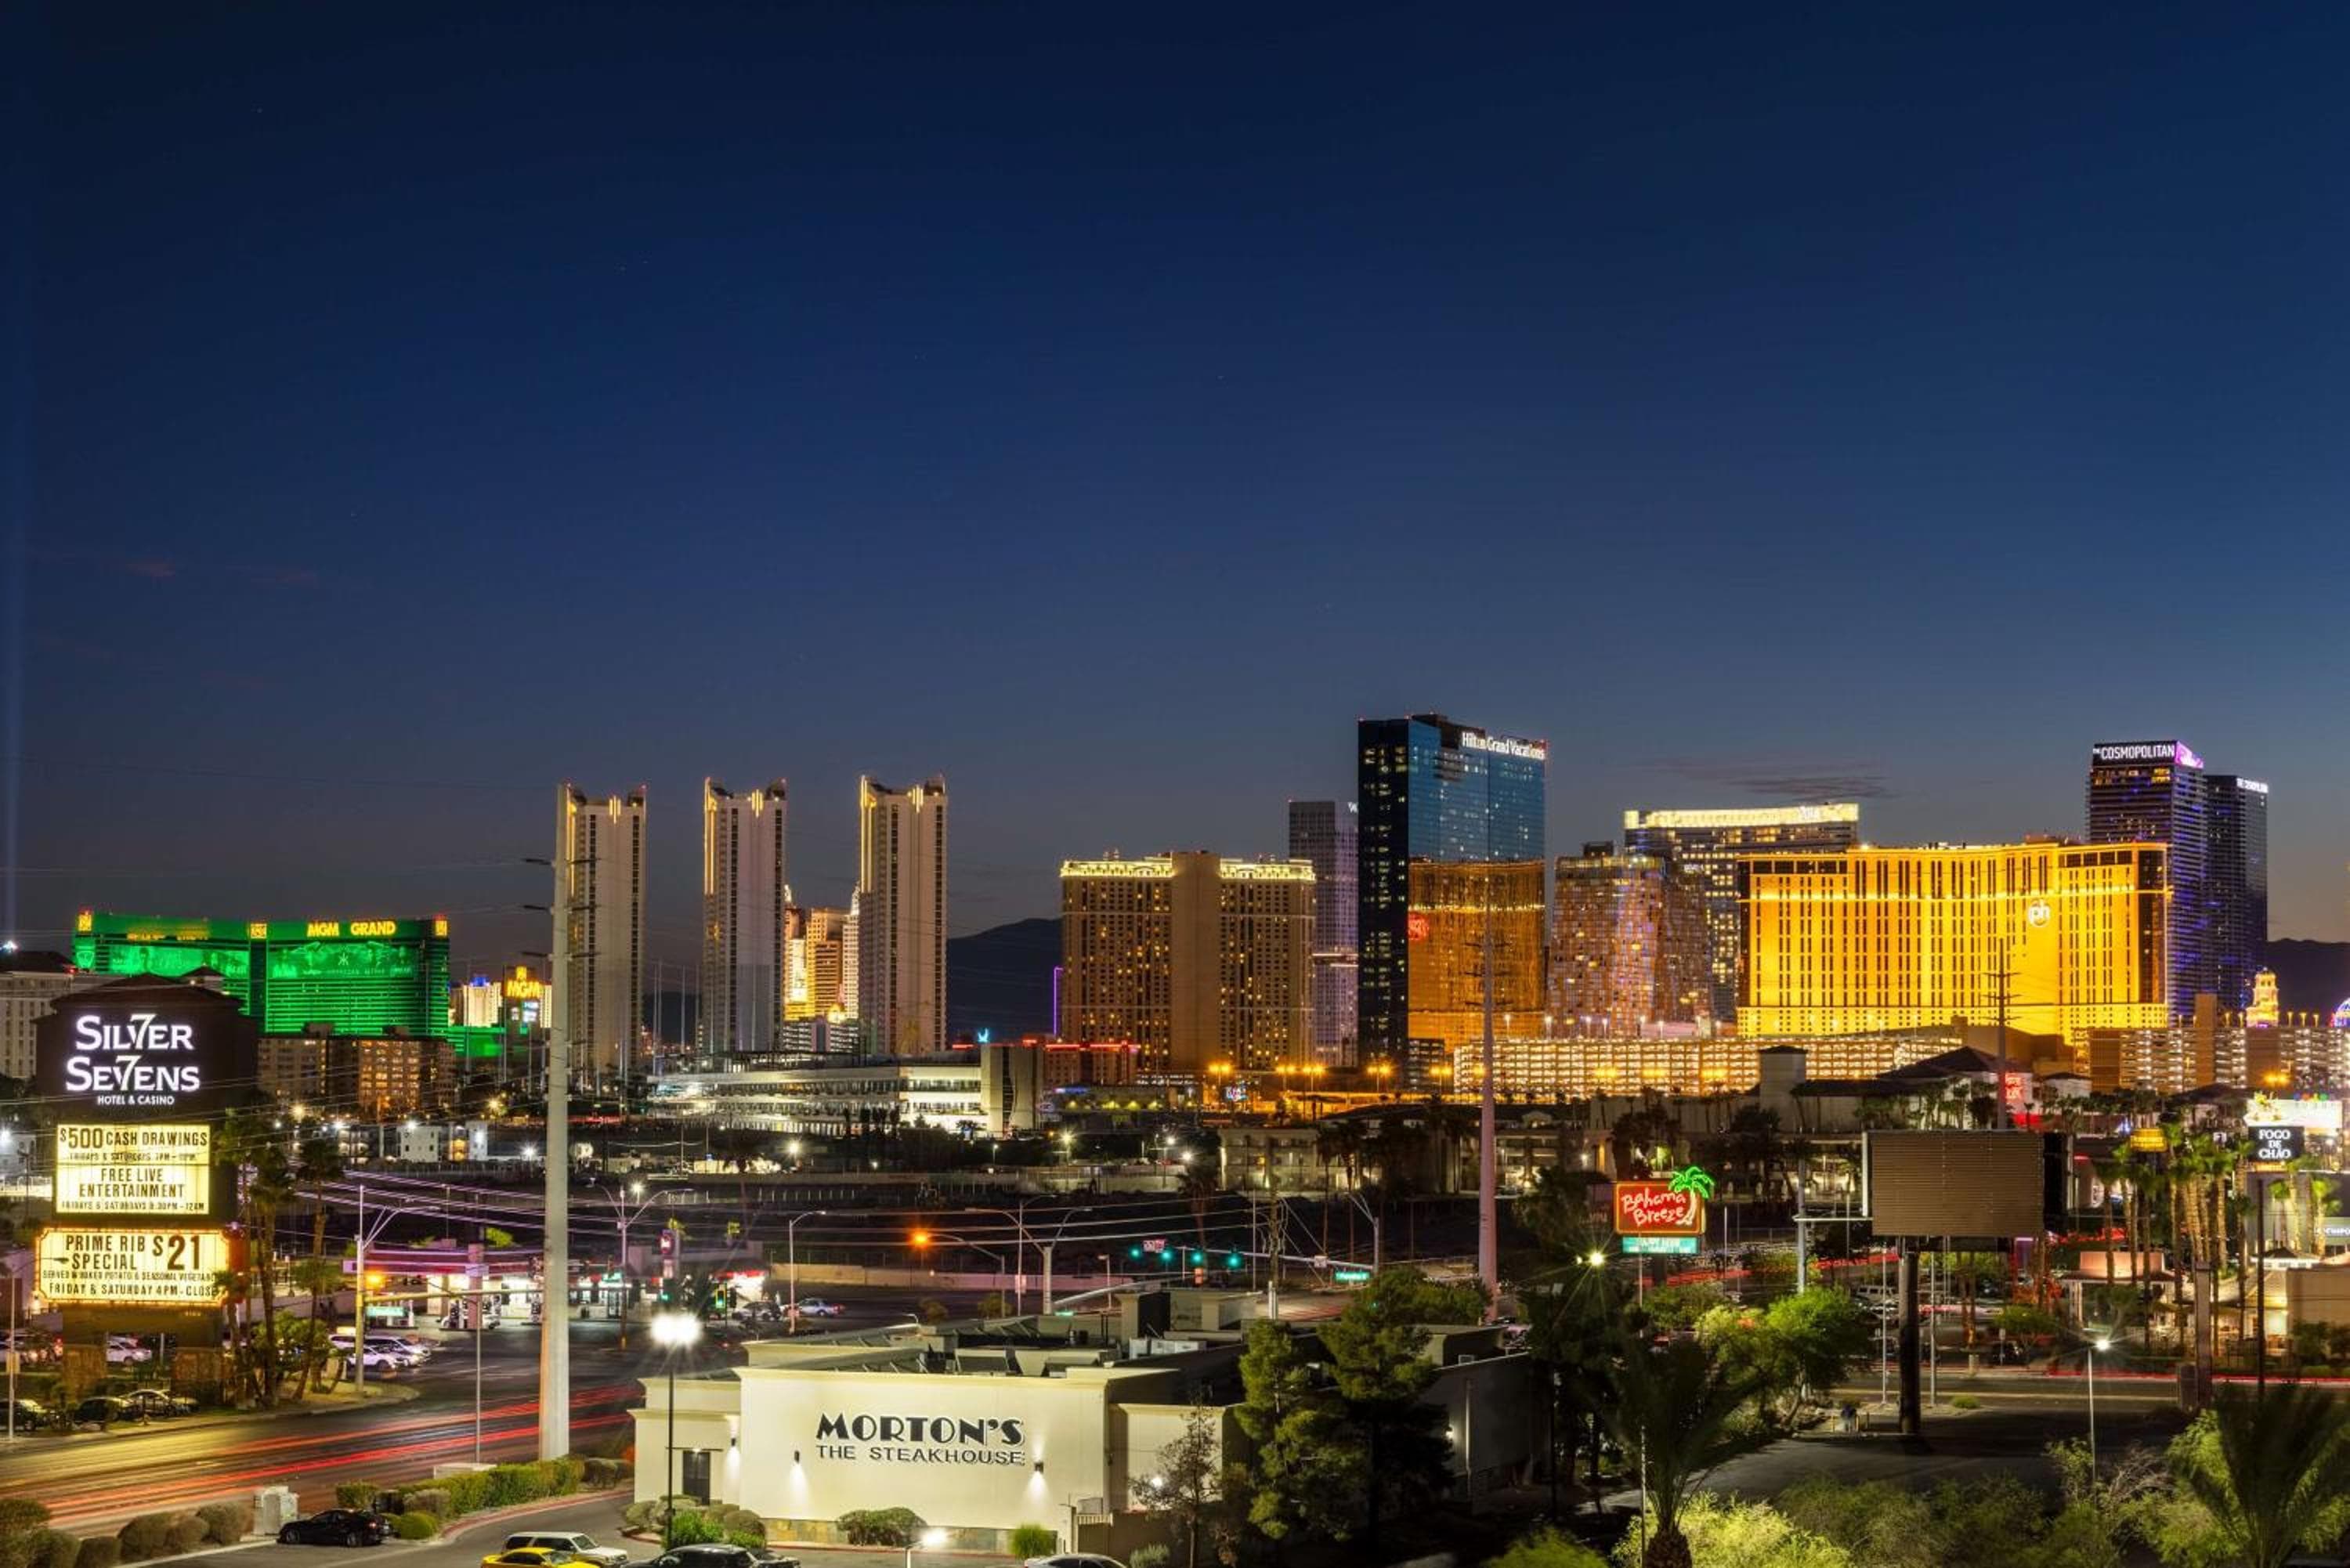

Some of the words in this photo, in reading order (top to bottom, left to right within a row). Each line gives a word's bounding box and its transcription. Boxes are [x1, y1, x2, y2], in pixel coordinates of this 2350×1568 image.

[1487, 736, 1509, 754] Grand
[2101, 745, 2175, 760] COSMOPOLITAN
[306, 922, 340, 937] MGM
[350, 920, 396, 936] GRAND
[506, 980, 541, 997] MGM
[97, 1096, 125, 1105] HOTEL
[128, 1095, 135, 1105] &
[137, 1095, 175, 1105] CASINO
[107, 1132, 137, 1145] CASH
[143, 1132, 207, 1146] DRAWINGS
[2258, 1129, 2290, 1140] FOGO
[2269, 1140, 2281, 1149] DE
[101, 1169, 132, 1182] FREE
[137, 1169, 164, 1182] LIVE
[79, 1183, 185, 1198] ENTERTAINMENT
[1621, 1187, 1687, 1214] Bahama
[1633, 1207, 1684, 1227] Breeze
[66, 1235, 112, 1252] PRIME
[120, 1235, 146, 1252] RIB
[72, 1253, 137, 1270] SPECIAL
[49, 1282, 85, 1295] FRIDAY
[101, 1284, 152, 1295] SATURDAY
[816, 1412, 1025, 1446] MORTON'S
[816, 1445, 856, 1460] THE
[870, 1447, 1025, 1466] STEAKHOUSE
